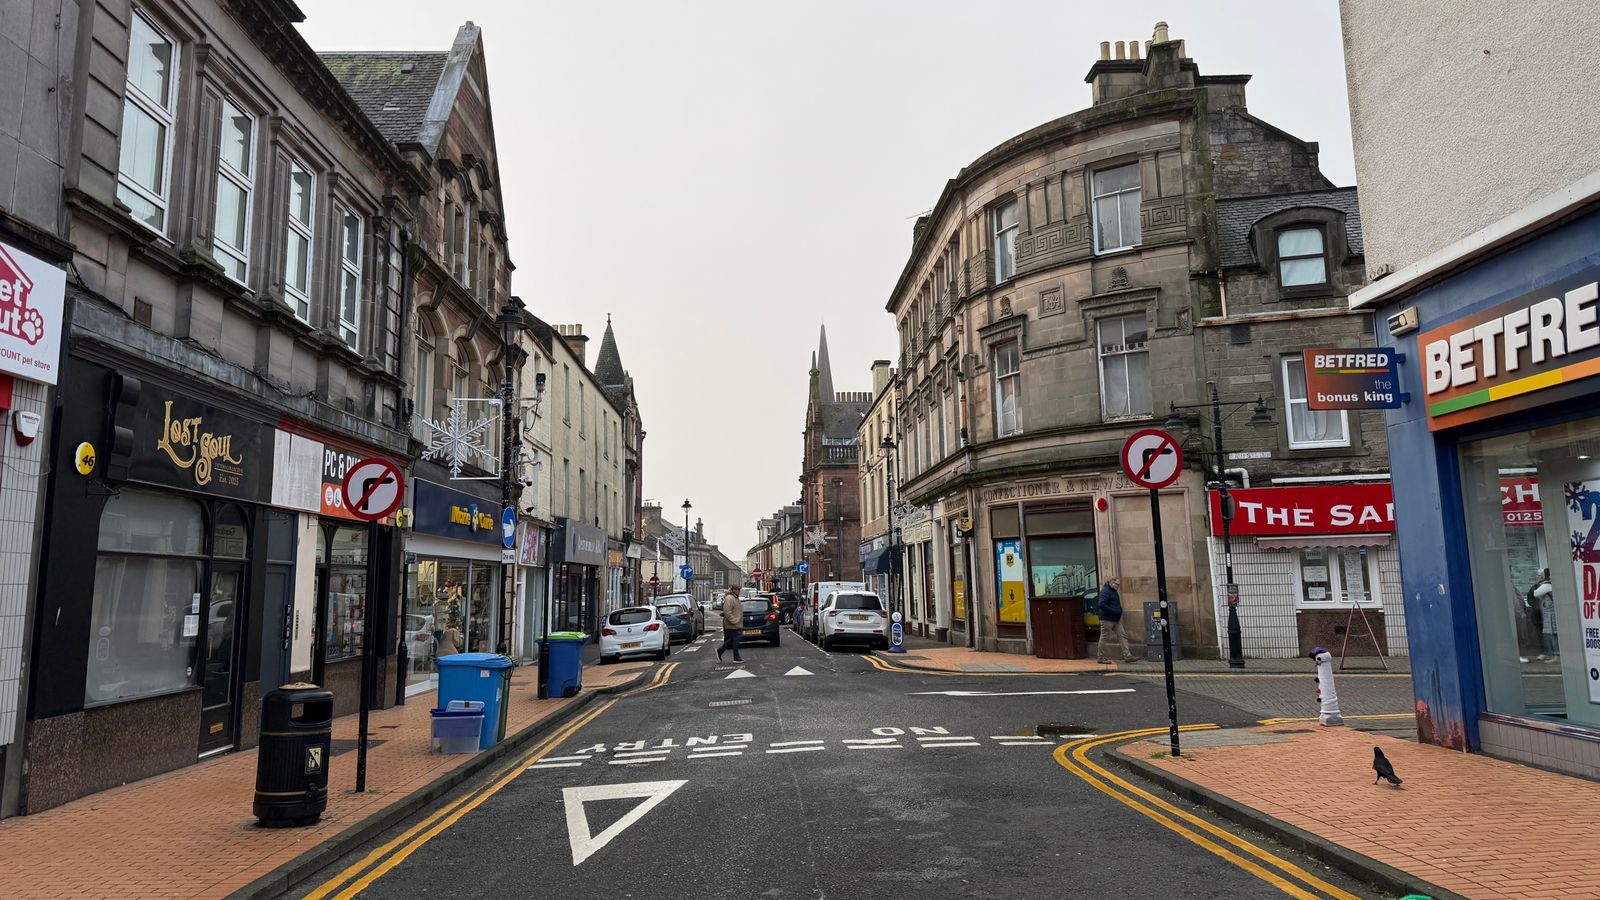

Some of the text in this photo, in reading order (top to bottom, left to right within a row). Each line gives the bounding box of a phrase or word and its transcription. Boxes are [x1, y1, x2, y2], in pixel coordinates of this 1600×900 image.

[1425, 281, 1600, 395] BETFRE
[0, 348, 51, 371] OUNT pet store
[1314, 353, 1389, 368] BETFRED
[1374, 380, 1392, 390] the
[1317, 391, 1393, 403] bonus king
[82, 455, 96, 467] 46
[324, 449, 337, 478] PC
[983, 481, 1062, 502] CONFECTIONER
[1066, 479, 1076, 492] &
[1239, 501, 1314, 527] THE
[1506, 512, 1542, 521] 0125
[1583, 601, 1596, 620] OF
[1586, 627, 1599, 638] FREE
